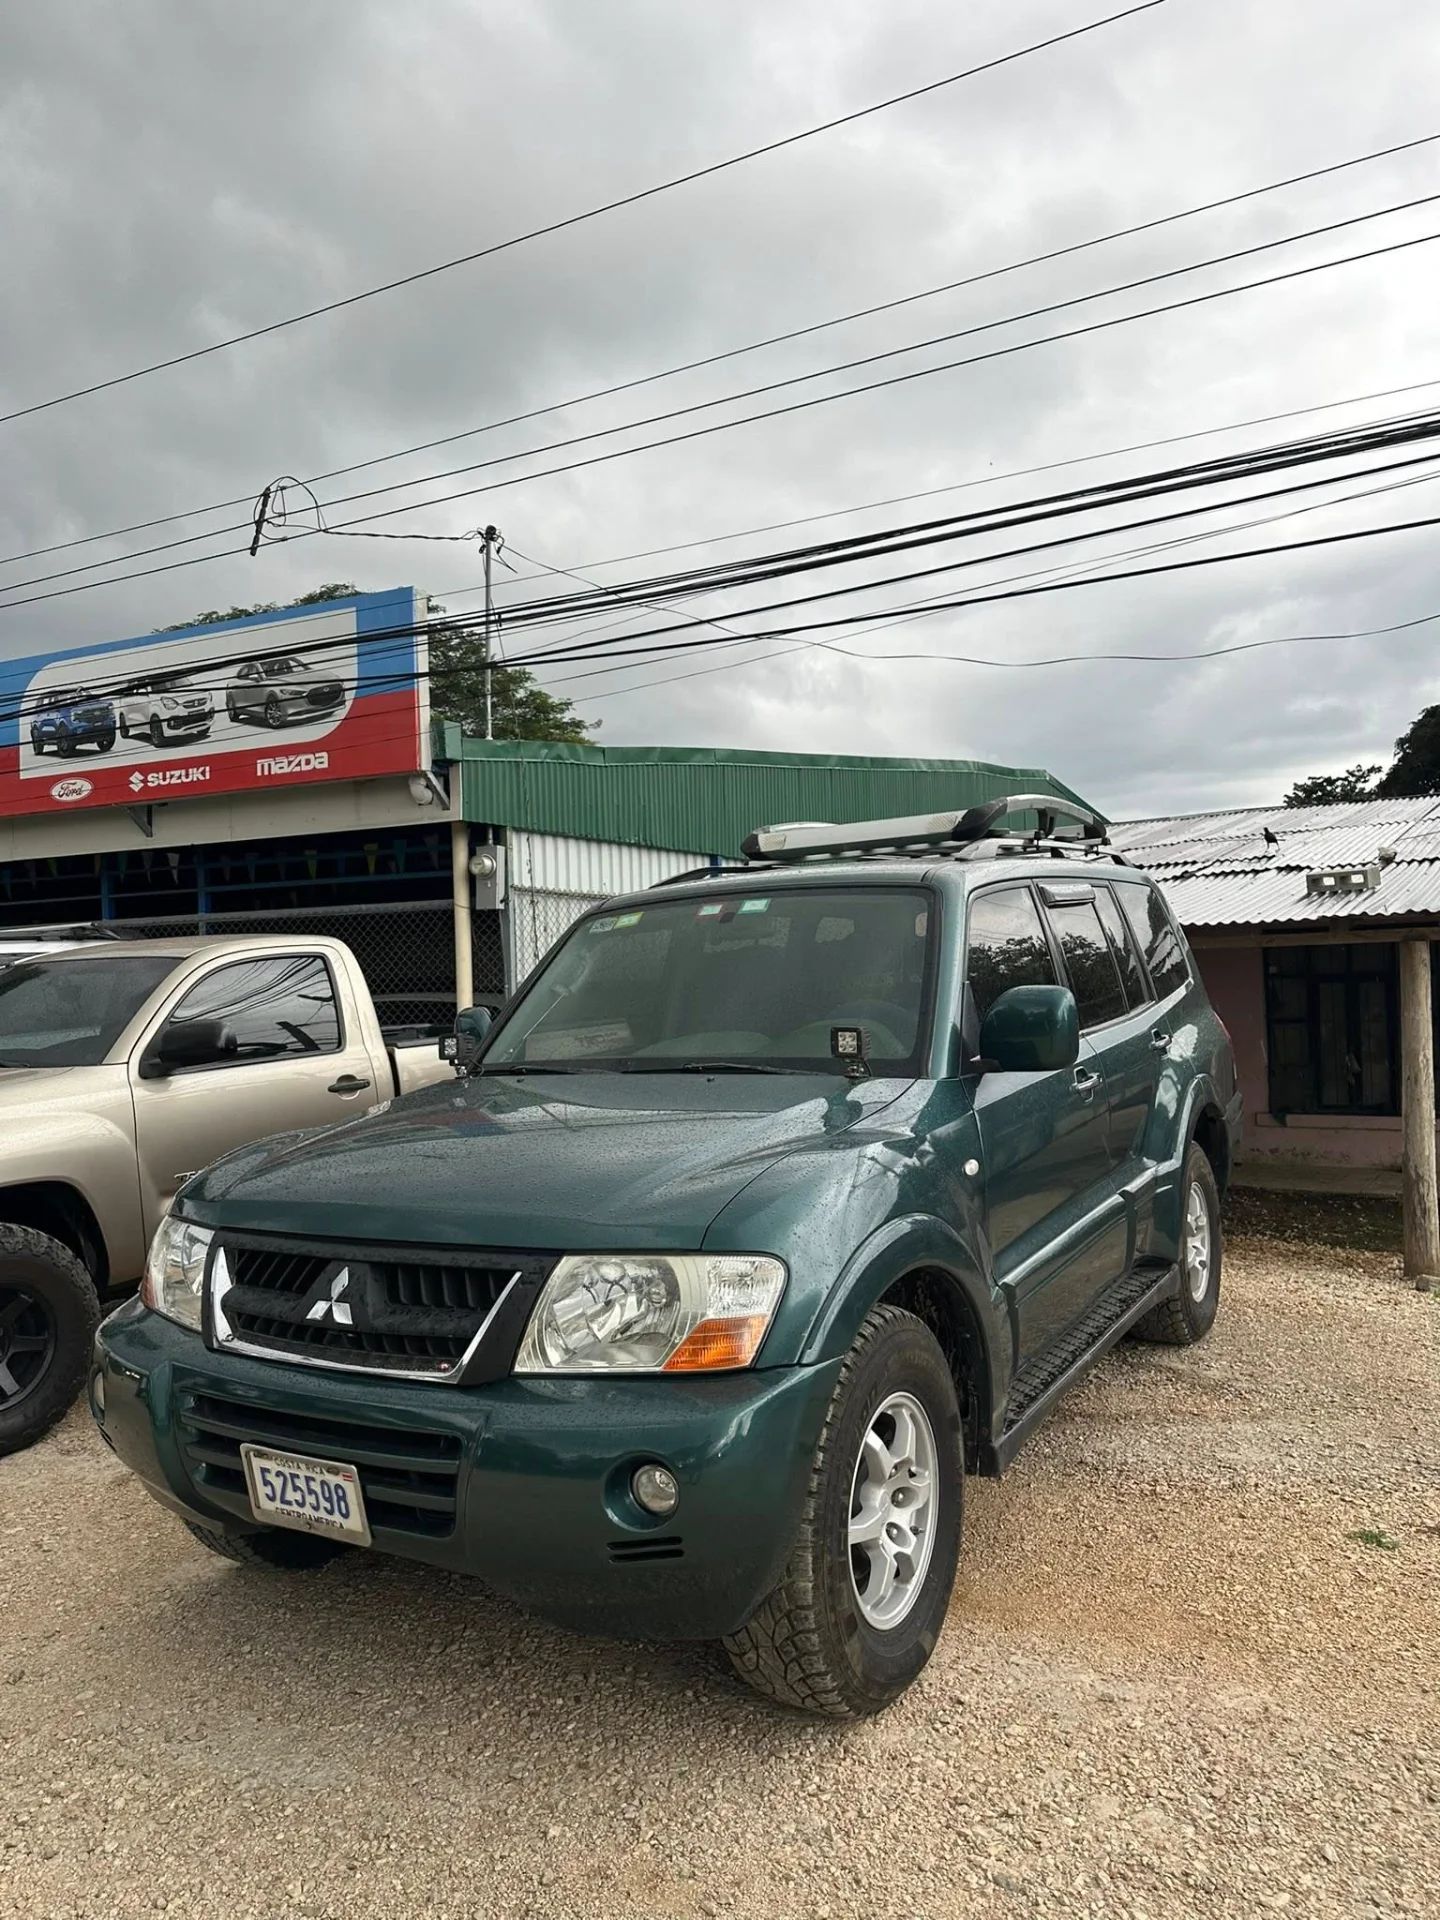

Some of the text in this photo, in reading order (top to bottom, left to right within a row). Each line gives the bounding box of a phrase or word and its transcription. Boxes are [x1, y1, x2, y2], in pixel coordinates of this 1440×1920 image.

[147, 766, 210, 787] SUZUKI
[58, 780, 90, 799] Ford
[259, 1466, 350, 1520] 525598
[275, 1506, 346, 1530] CENTROAMERICA
